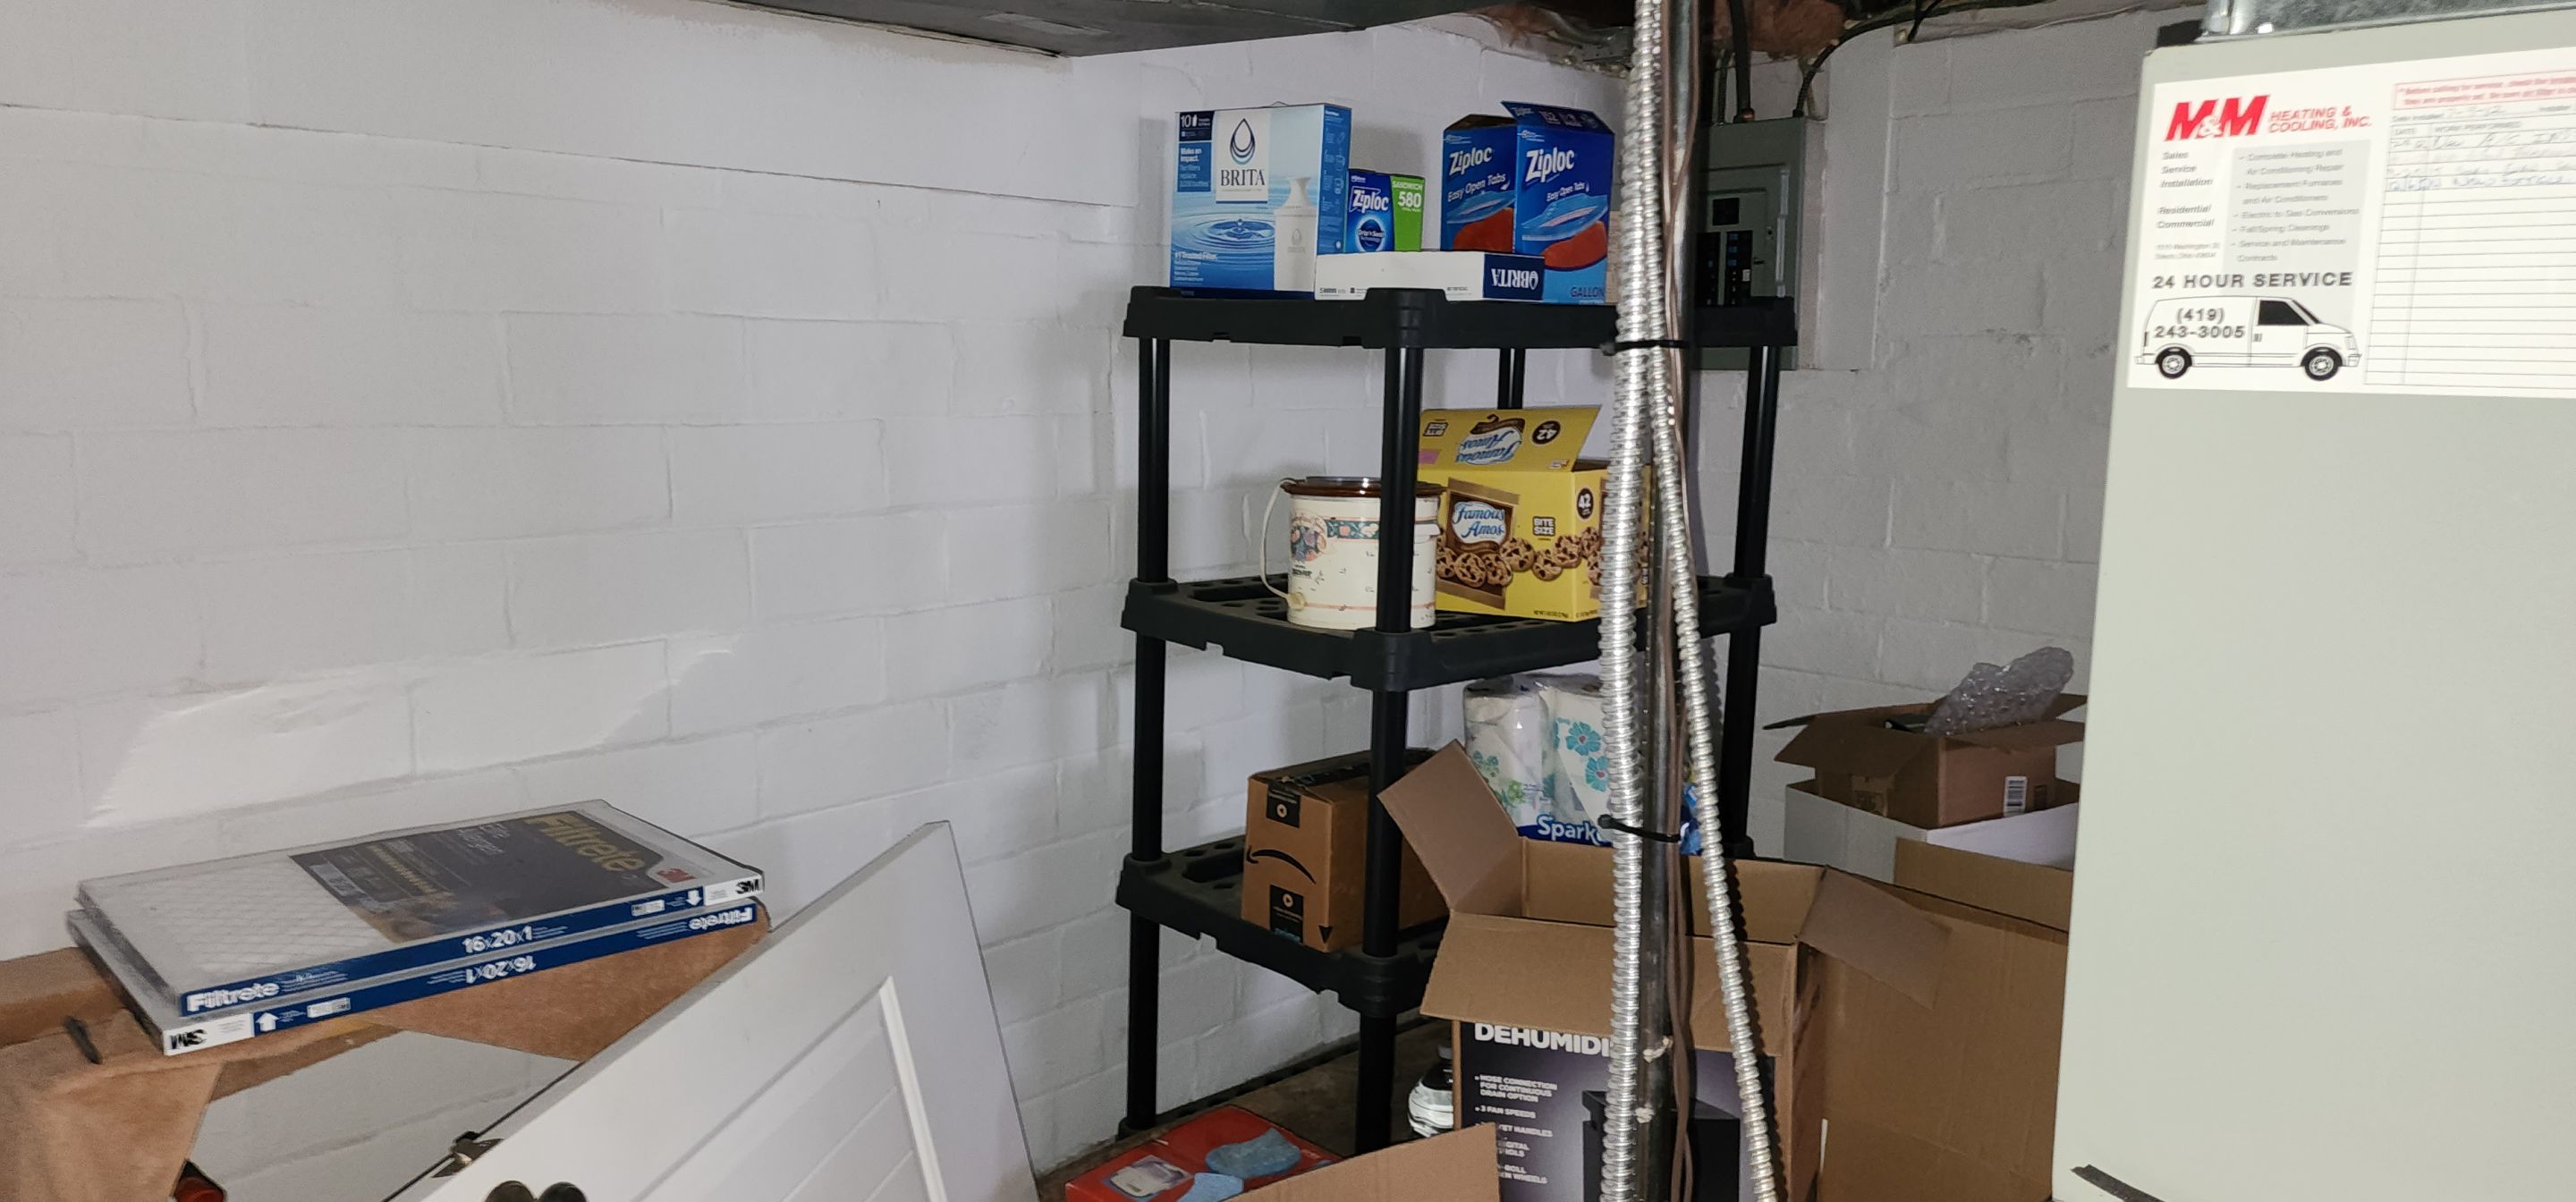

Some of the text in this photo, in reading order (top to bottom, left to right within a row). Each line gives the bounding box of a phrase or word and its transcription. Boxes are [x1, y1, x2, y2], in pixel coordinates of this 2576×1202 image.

[1181, 114, 1191, 128] 10
[2270, 105, 2352, 122] HEATING &
[2268, 116, 2372, 133] COOLING, INC.
[1449, 147, 1493, 176] Ziploc
[1525, 147, 1575, 183] Ziploc
[1220, 168, 1266, 187] BRITA
[1447, 173, 1506, 203] Easy Open Tabs
[1352, 190, 1389, 214] Ziploc
[1398, 190, 1422, 207] 580
[1491, 268, 1530, 289] BRITA
[2152, 272, 2354, 289] 24 HOUR SERVICE
[2176, 308, 2225, 325] (419)
[2154, 326, 2246, 339] 243-3005
[1579, 494, 1591, 509] 42
[1453, 502, 1505, 524] Famous
[1462, 521, 1504, 538] Amos
[1533, 518, 1555, 527] BITE
[1533, 526, 1555, 536] SIZE
[462, 926, 533, 953] 16x20x1
[187, 983, 280, 1012] Filtrete
[1474, 1022, 1614, 1058] DEHUMIDI
[1479, 1082, 1497, 1090] FOR
[1503, 1078, 1558, 1090] CONNECTION
[1506, 1093, 1538, 1103] OPTION
[1487, 1105, 1504, 1114] FAN
